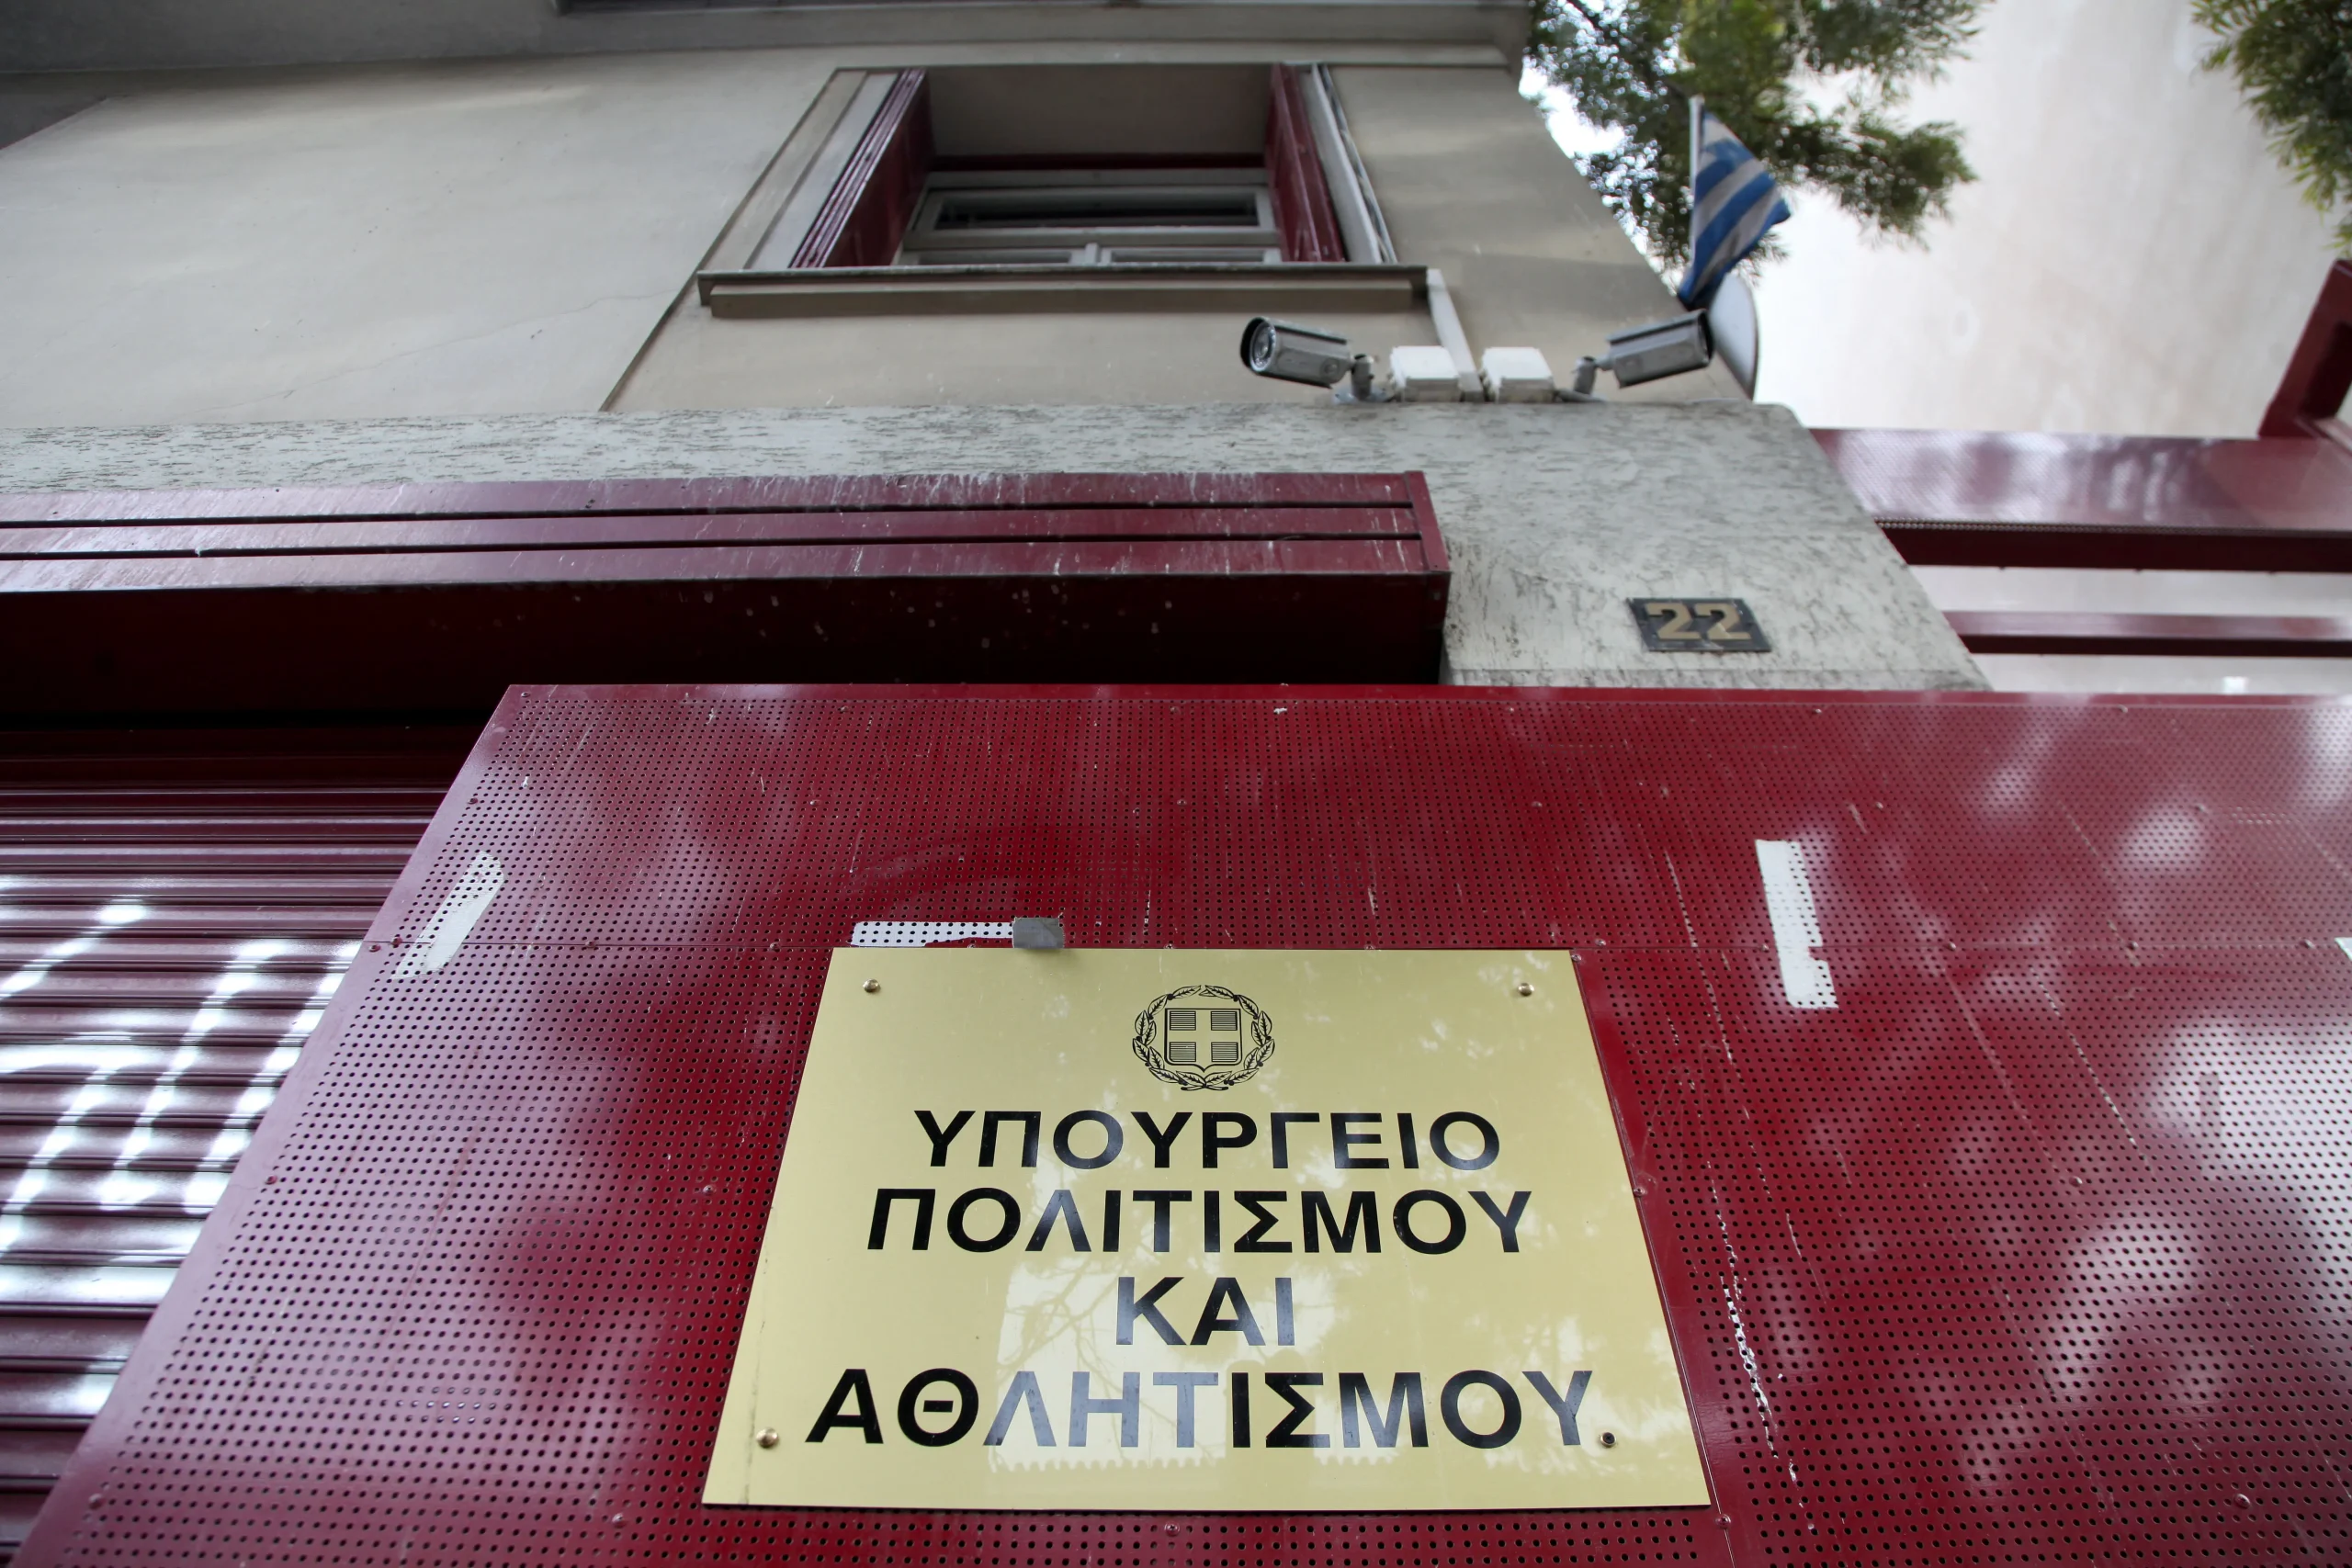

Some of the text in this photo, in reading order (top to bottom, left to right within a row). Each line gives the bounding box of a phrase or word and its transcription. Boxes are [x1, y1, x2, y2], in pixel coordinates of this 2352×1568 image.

[1645, 602, 1751, 640] 22
[914, 1110, 1500, 1170] ΥΠΟΥΡΓΕΙΟ
[867, 1187, 1532, 1255] ΠΟΛΙΤΙΣΜΟΥ
[1115, 1276, 1295, 1347] ΚΑΙ
[805, 1368, 1593, 1450] ΑΘΛΗΤΙΣΜΟΥ
